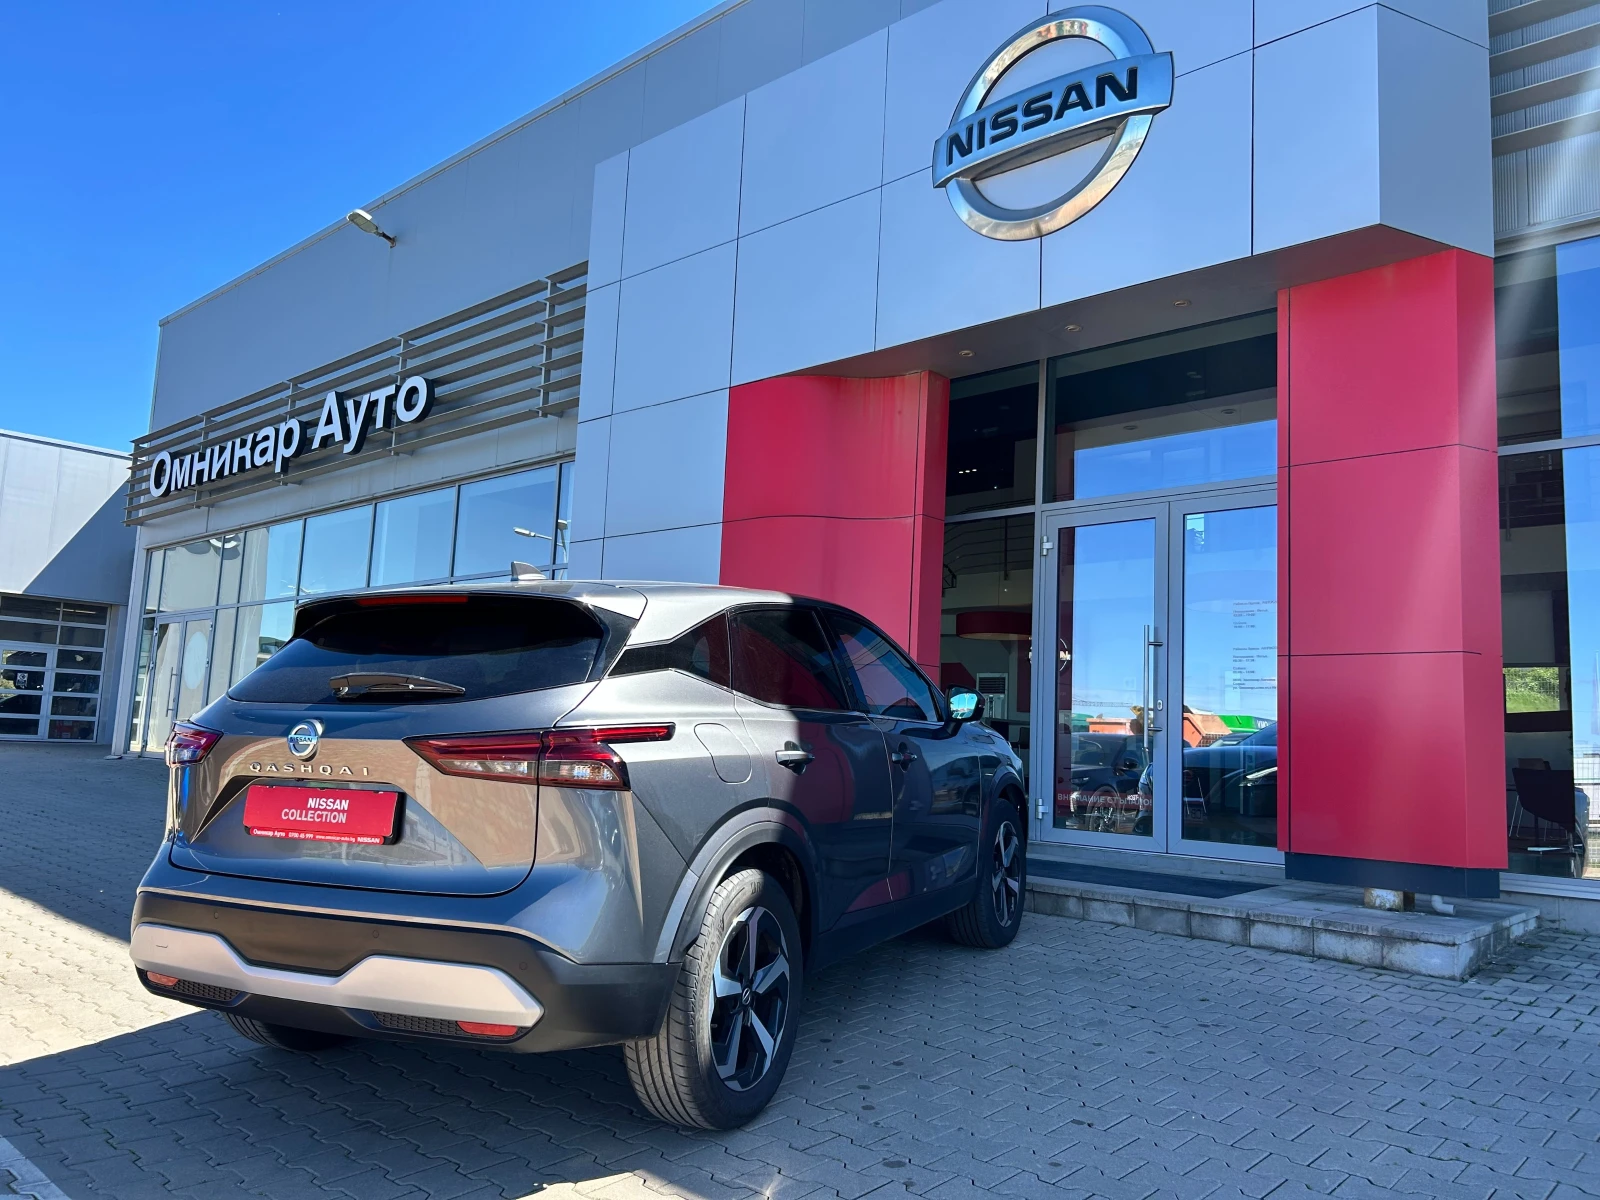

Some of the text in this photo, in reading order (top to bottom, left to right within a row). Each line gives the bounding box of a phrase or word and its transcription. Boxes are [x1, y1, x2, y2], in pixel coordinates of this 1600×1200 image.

[946, 66, 1139, 167] NISSAN
[149, 376, 428, 498] Омникар Ауто
[249, 761, 369, 776] QASHQAI
[307, 797, 350, 811] NISSAN
[281, 808, 347, 824] COLLECTION
[357, 836, 381, 844] NISSAN
